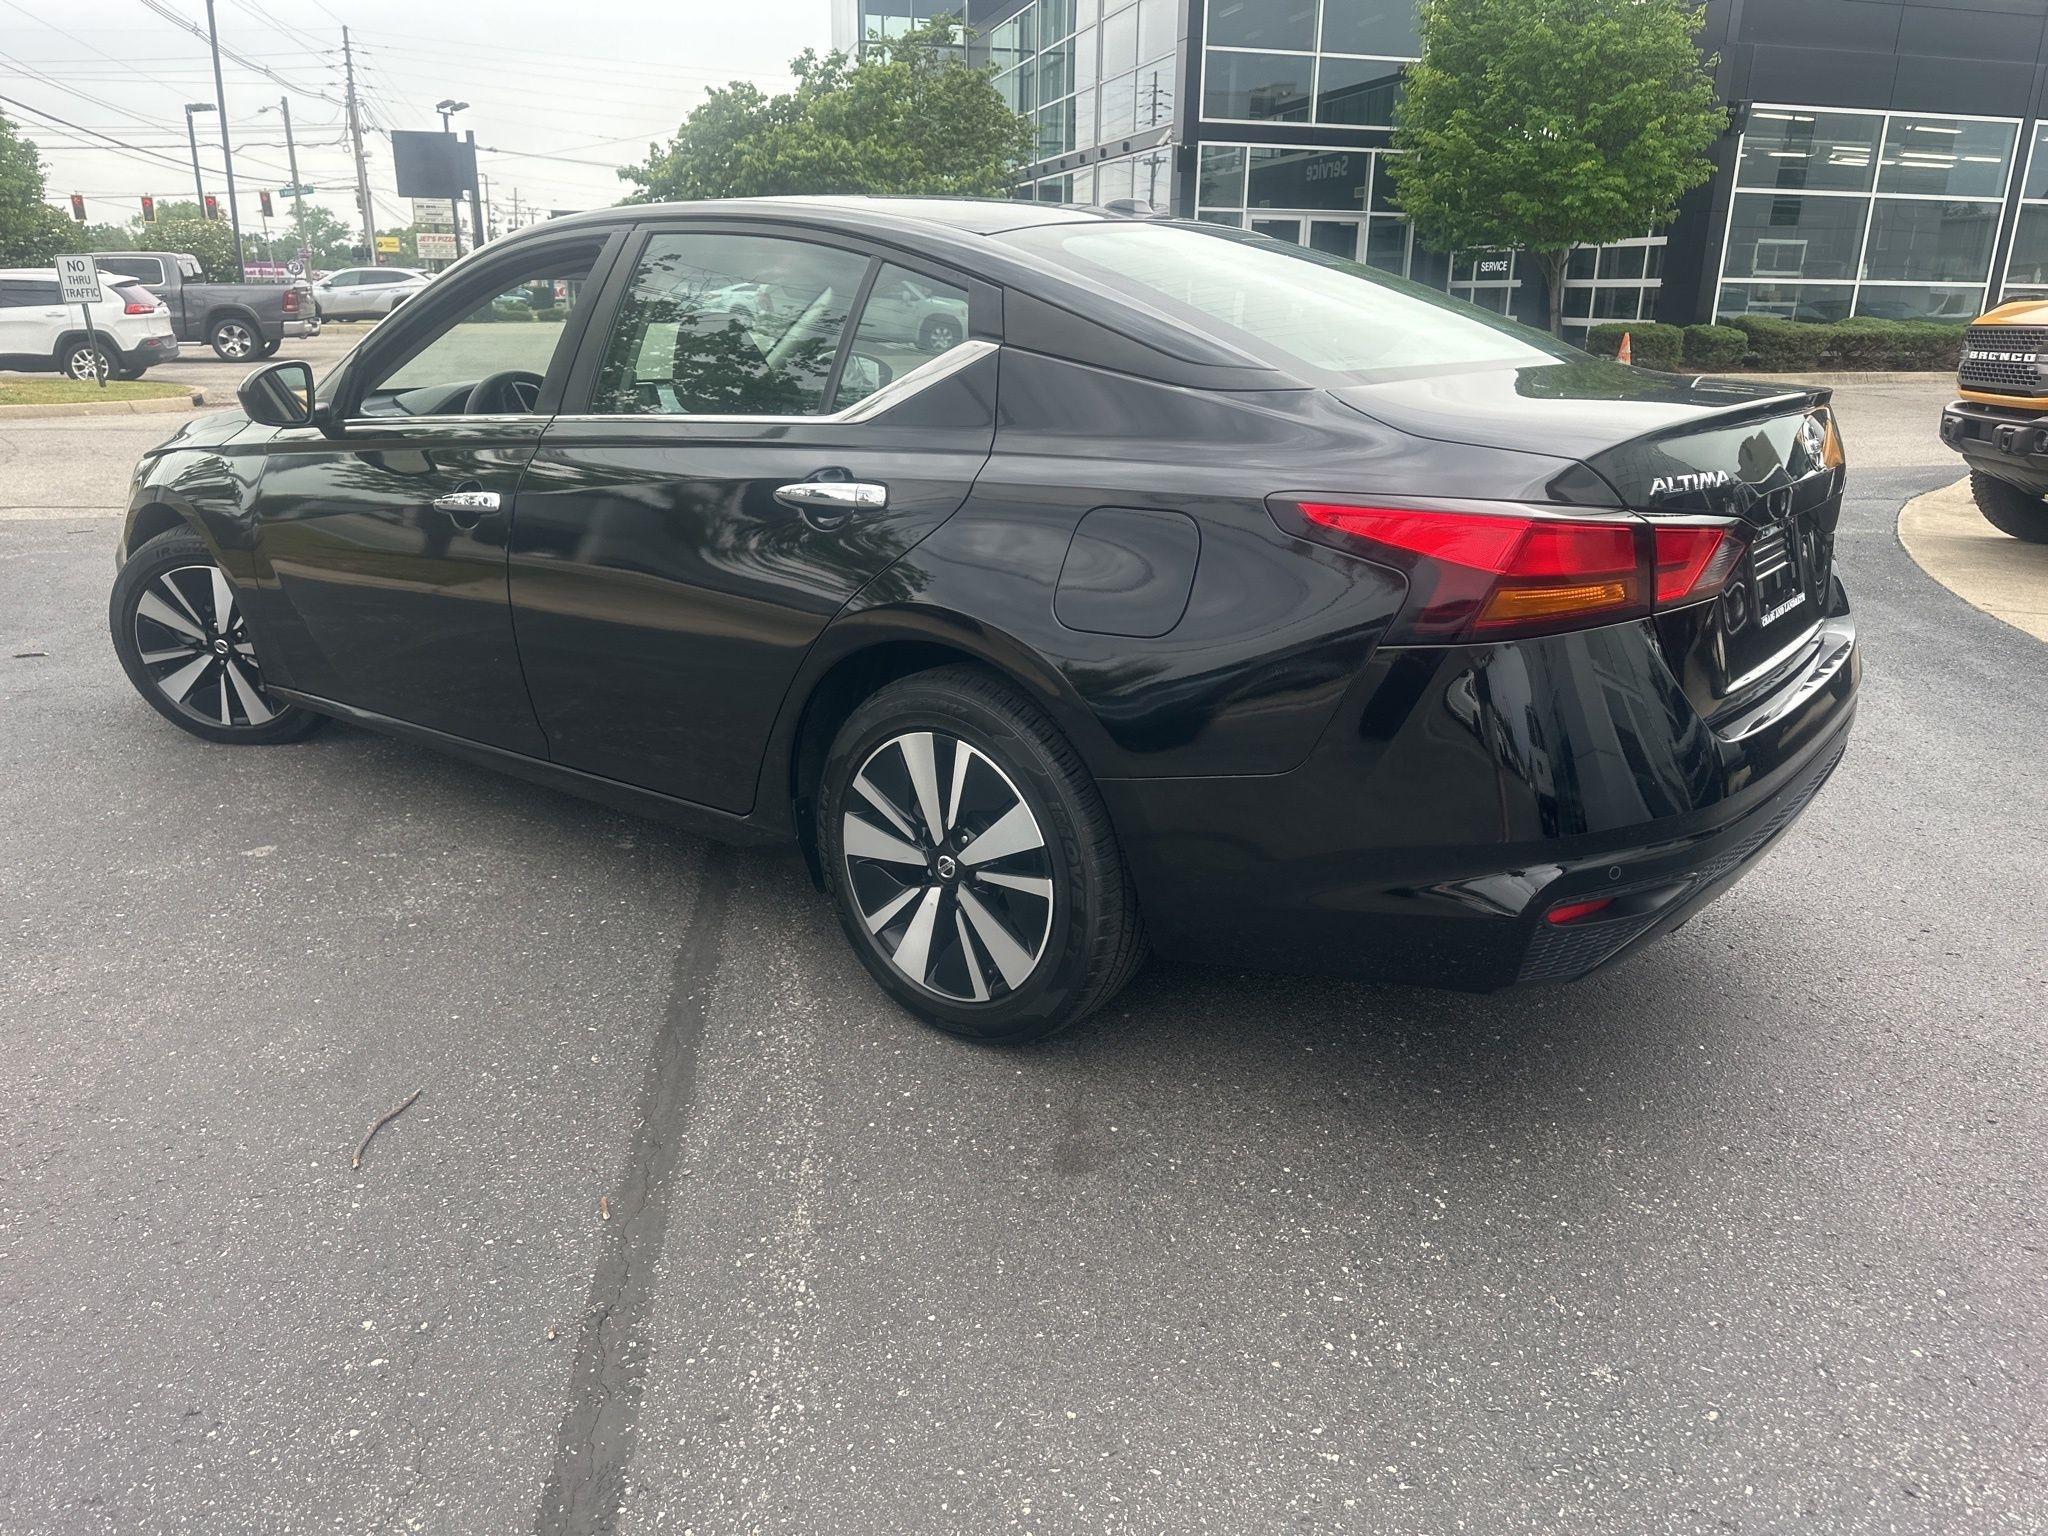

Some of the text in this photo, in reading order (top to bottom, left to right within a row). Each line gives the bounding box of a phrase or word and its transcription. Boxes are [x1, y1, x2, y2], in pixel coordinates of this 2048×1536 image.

[67, 260, 85, 272] NO
[1480, 260, 1508, 272] SERVICE
[67, 275, 91, 285] THRU
[65, 288, 99, 298] TRAFFIC
[1969, 351, 2037, 362] BRONCO
[1649, 470, 1730, 496] ALTIMA
